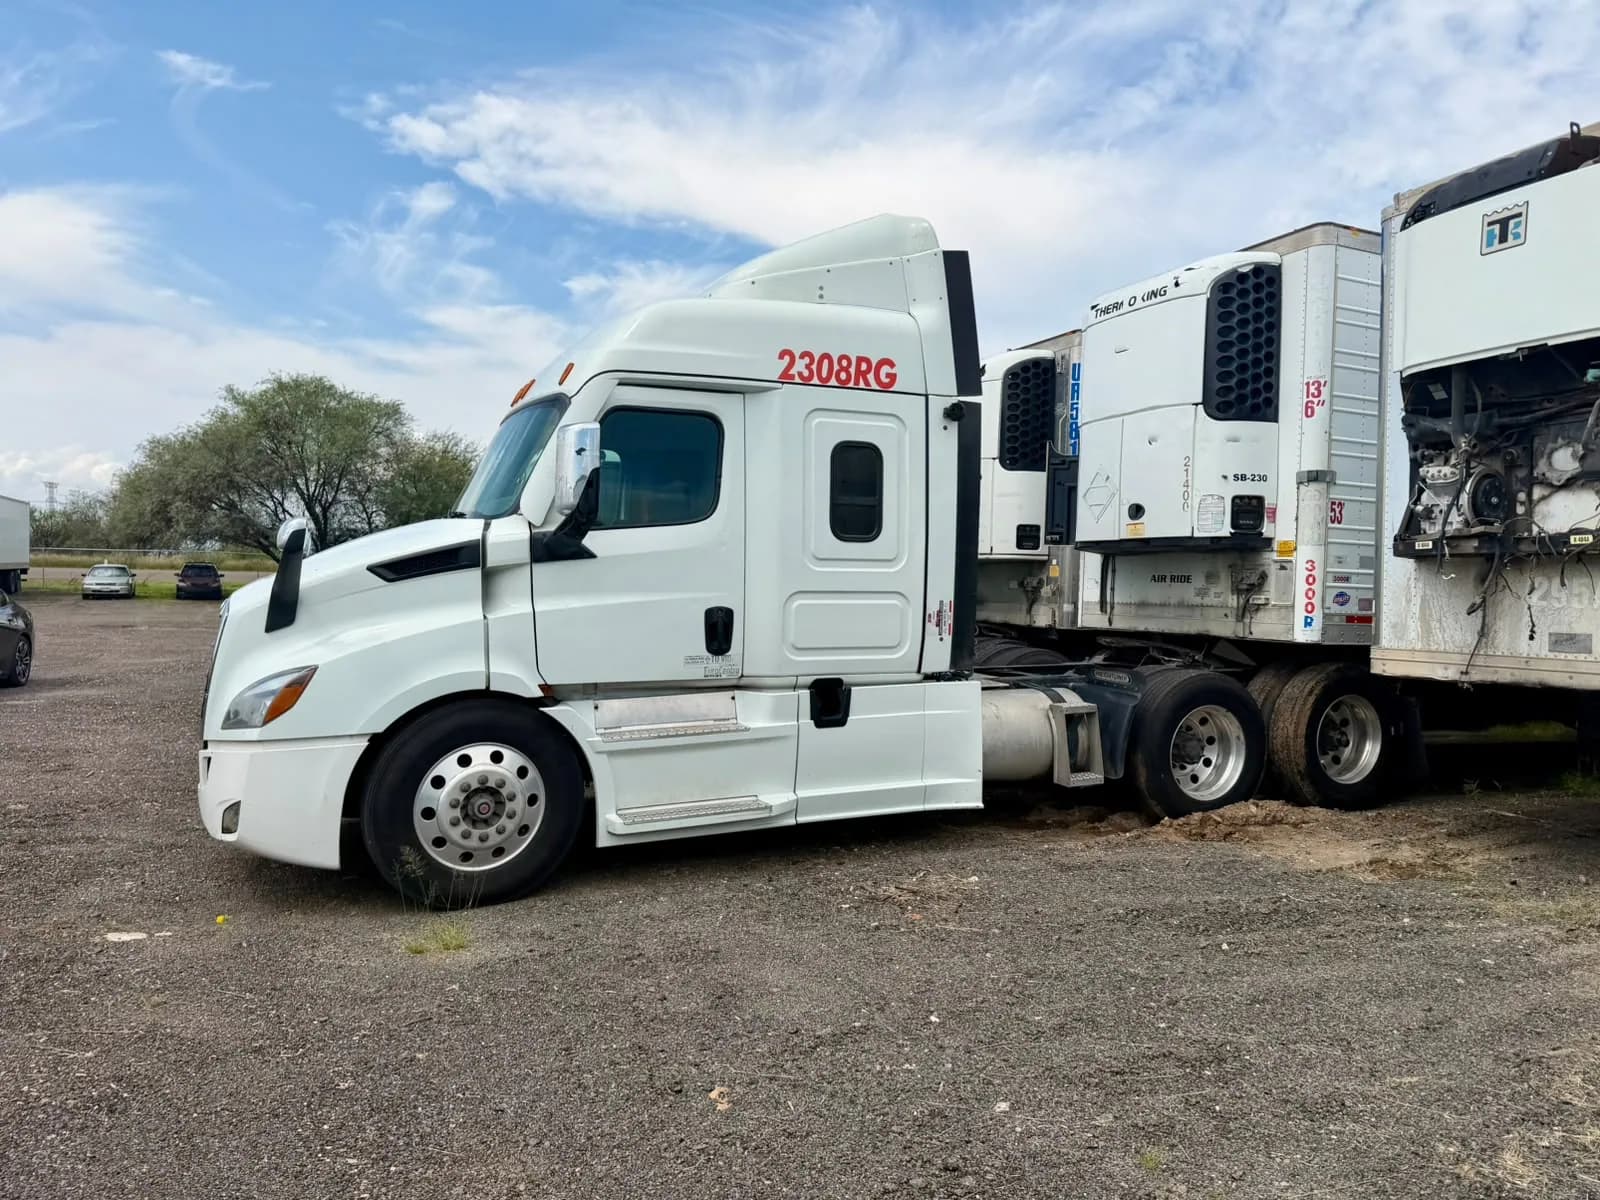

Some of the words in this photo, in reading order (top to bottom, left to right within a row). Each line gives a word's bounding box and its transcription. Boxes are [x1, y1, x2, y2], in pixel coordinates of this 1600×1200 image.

[777, 348, 897, 390] 2308RG
[1232, 473, 1268, 483] SB-230
[1149, 574, 1167, 584] AIR
[1169, 574, 1193, 585] RIDE
[1303, 559, 1317, 629] 3000R
